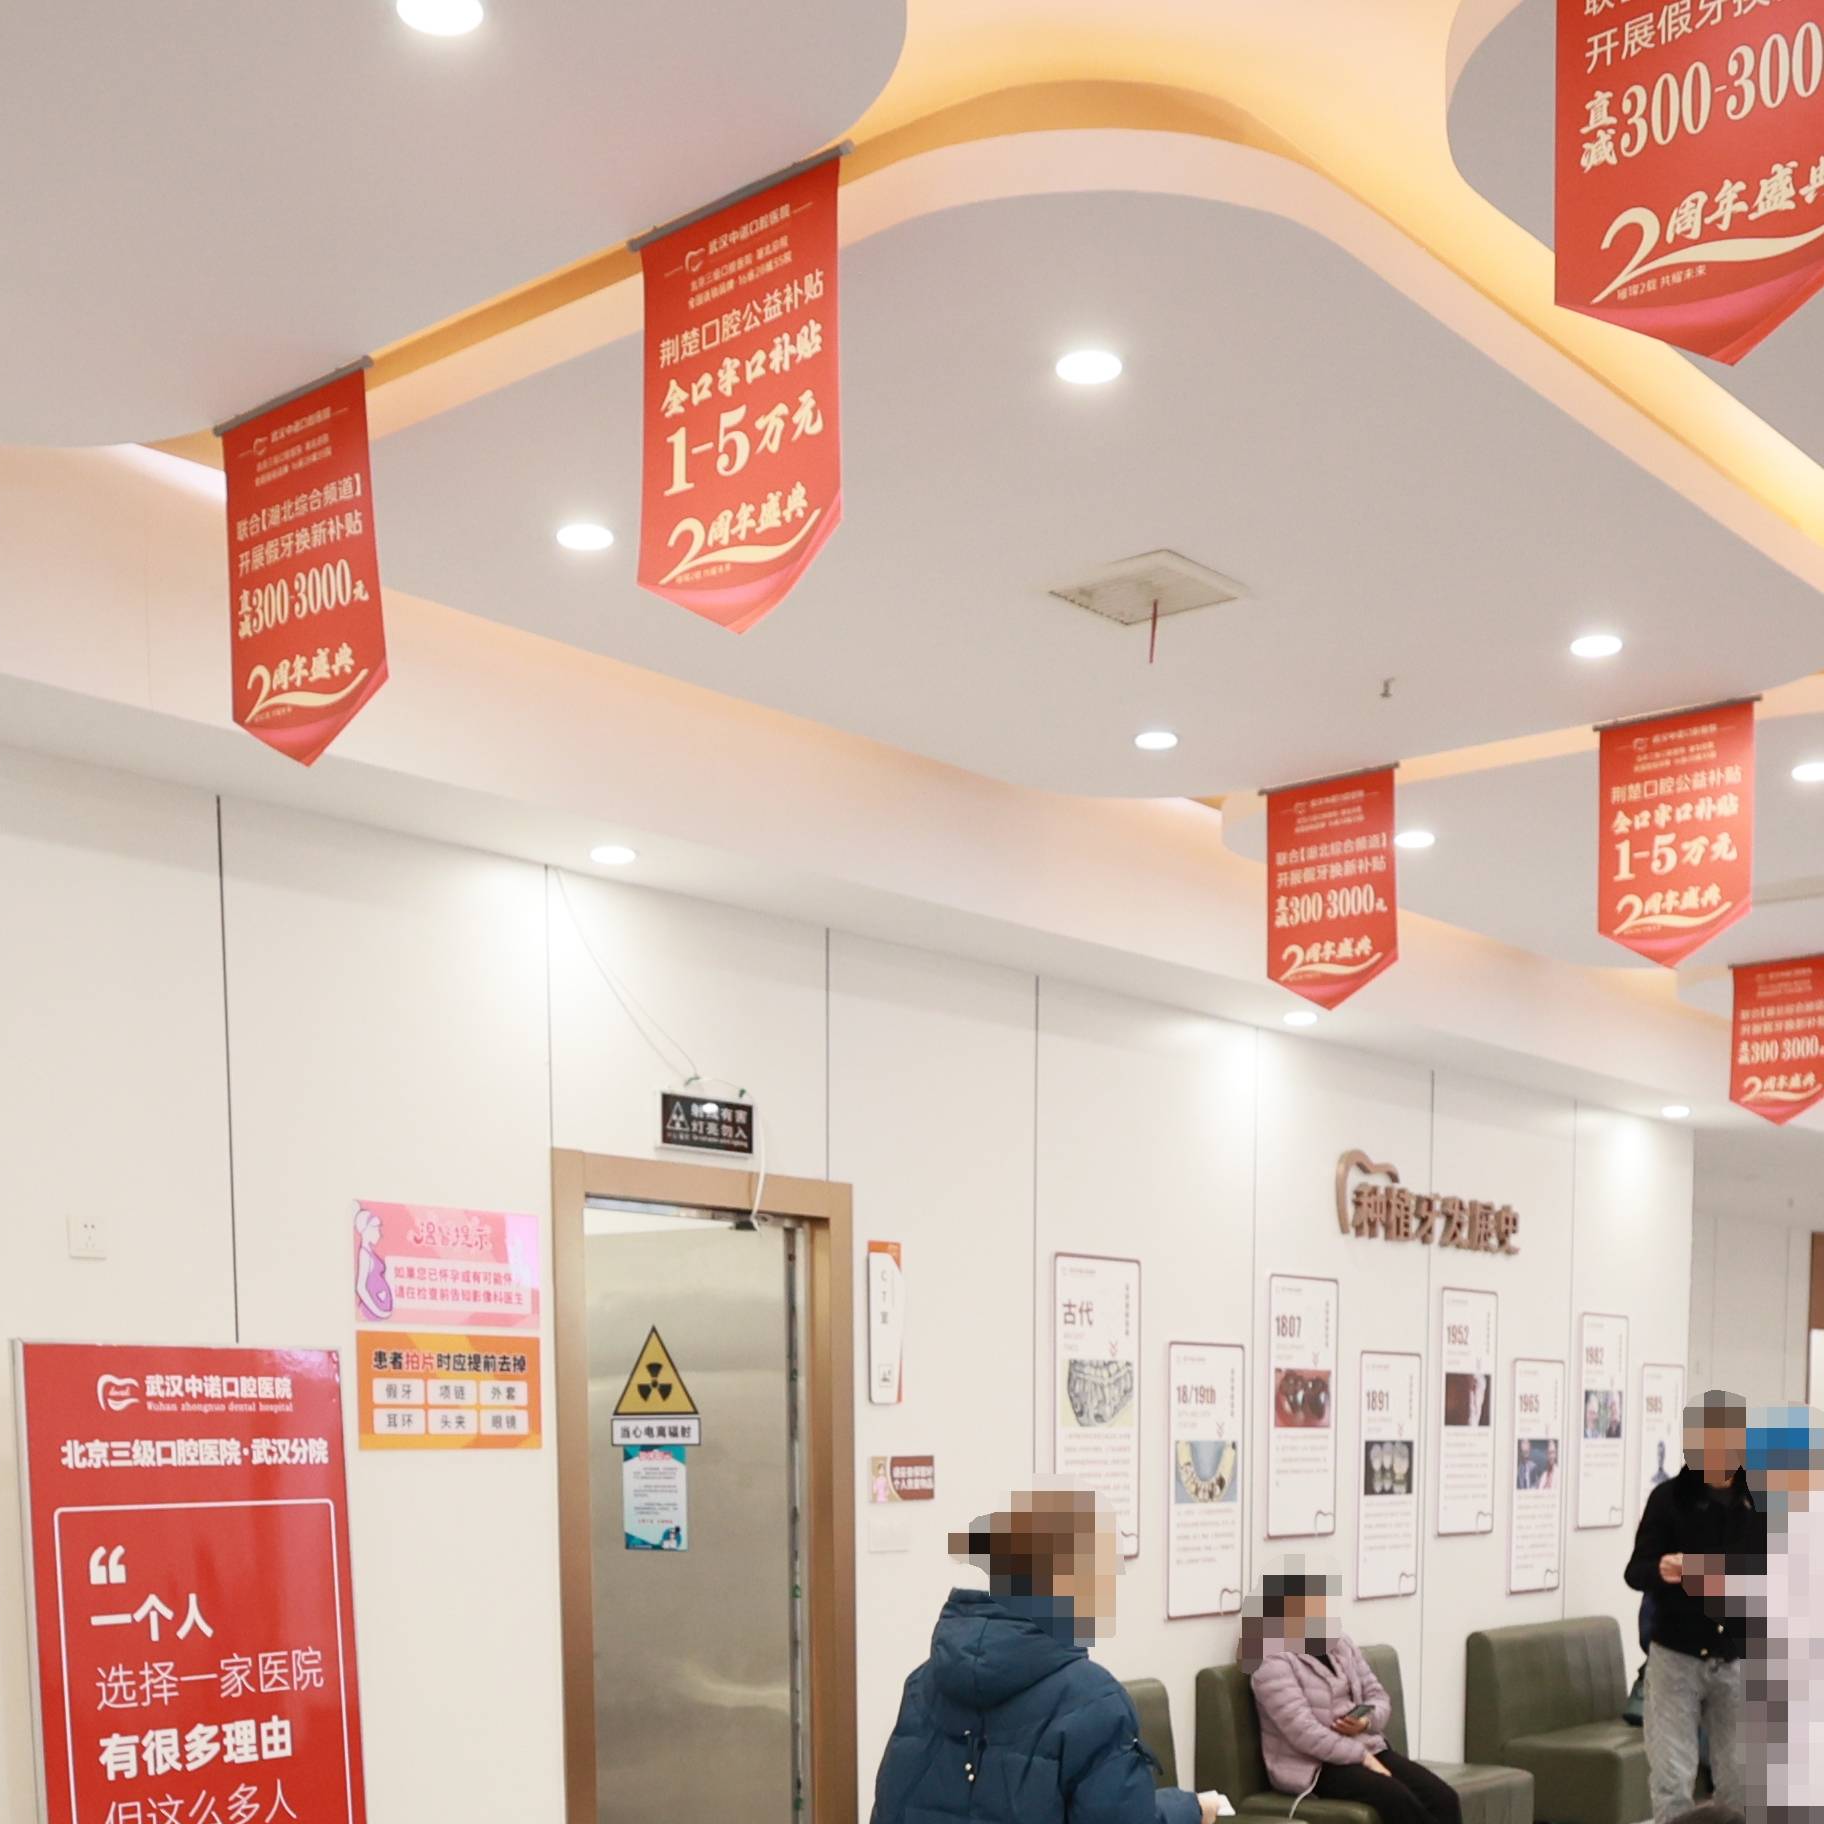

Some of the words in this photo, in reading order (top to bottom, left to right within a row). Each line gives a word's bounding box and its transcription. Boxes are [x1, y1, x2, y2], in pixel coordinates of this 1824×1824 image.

[659, 268, 824, 369] 荆楚口腔公益补贴
[664, 389, 824, 497] 1-5万元
[238, 509, 363, 579] 开展假牙换新补贴
[659, 480, 816, 584] 2周年盛典
[245, 641, 364, 723] 2周年盛典
[1613, 831, 1738, 882] 1-5万元
[1063, 1299, 1094, 1328] 古代
[1275, 1314, 1302, 1338] 1807
[1446, 1323, 1470, 1346] 1952
[373, 1350, 526, 1374] 患者拍片时应提前去掉
[145, 1374, 293, 1399] 武汉中诺口腔医院
[385, 1383, 412, 1401] 假牙
[1176, 1384, 1216, 1405] 18/19th
[1365, 1390, 1389, 1412] 1891
[386, 1412, 413, 1429] 耳环
[491, 1414, 517, 1431] 眼镜
[61, 1438, 329, 1469] 北京三级口腔医院·武汉分院
[91, 1592, 214, 1642] 一个人
[96, 1645, 325, 1712] 选择一家医院
[98, 1714, 293, 1780] 有很多理由
